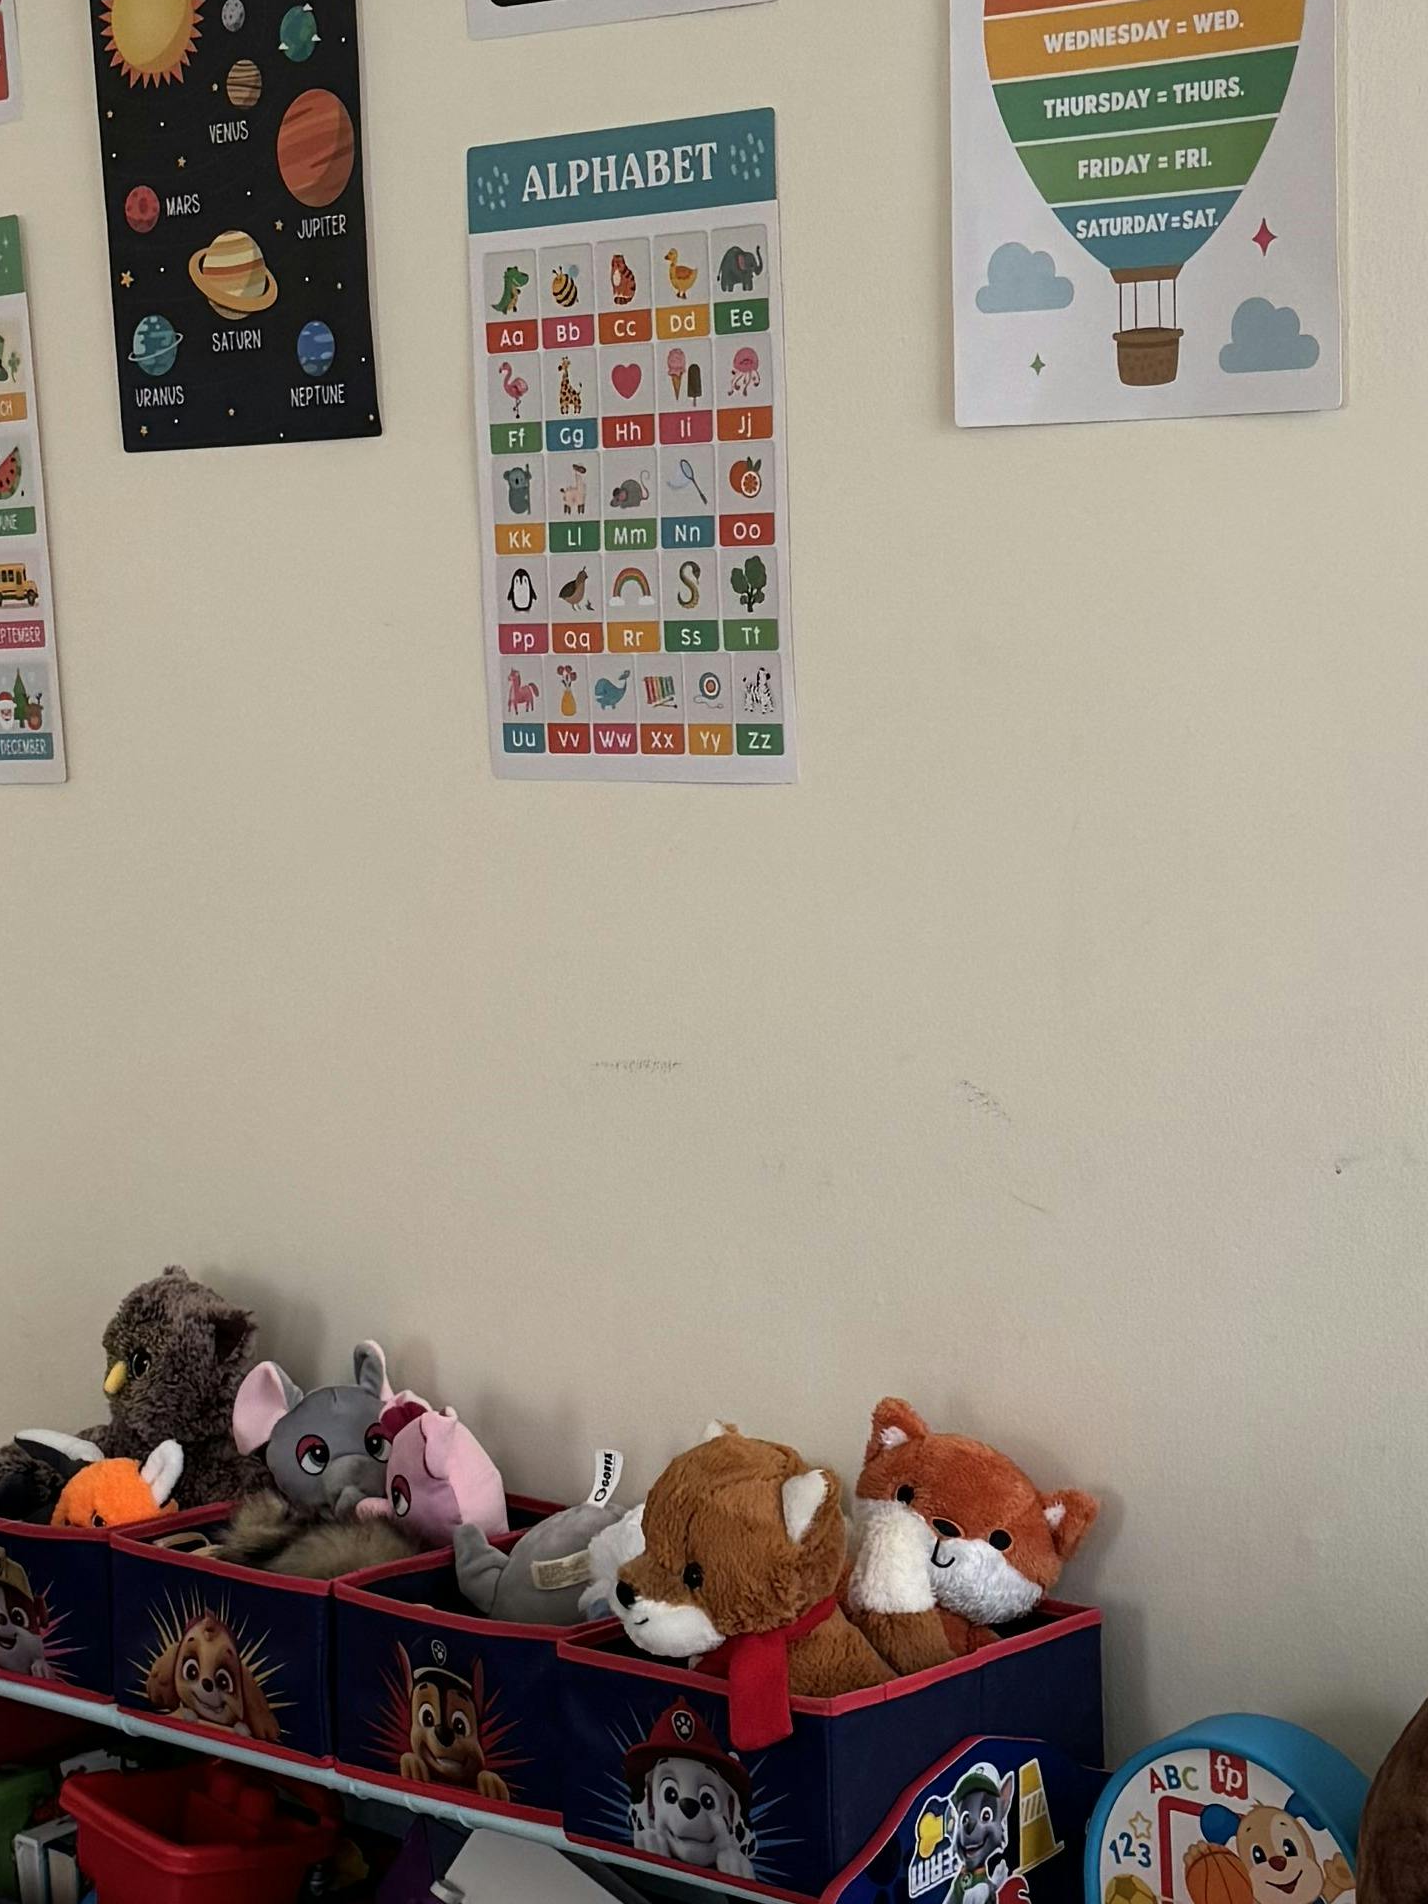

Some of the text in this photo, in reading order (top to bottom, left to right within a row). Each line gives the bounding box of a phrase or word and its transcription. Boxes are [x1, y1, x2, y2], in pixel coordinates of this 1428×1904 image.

[1043, 18, 1171, 54] WEDNESDAY
[1192, 9, 1245, 34] WED.
[1043, 87, 1151, 119] THURSDAY
[1172, 76, 1245, 104] THURS.
[208, 119, 249, 144] VENUS
[521, 141, 718, 203] ALPHABET
[1077, 153, 1151, 180] FRIDAY
[1175, 147, 1213, 170] FRI.
[165, 193, 201, 217] MARS
[296, 213, 347, 240] JUPITER
[1076, 212, 1169, 240] SATURDAY
[1182, 207, 1219, 230] SAT.
[211, 328, 262, 352] SATURN
[499, 308, 754, 347] Aa Bb Cc Dd Ee
[135, 385, 185, 408] URANUS
[290, 383, 345, 408] NEPTUNE
[508, 412, 752, 449] Ff Gg Hh Ii Jj
[508, 521, 761, 549] Kk Ll Mm Nn Oo
[512, 626, 761, 652] Pp Qq Rr Ss Tt
[0, 738, 48, 756] DECEMBER
[512, 730, 772, 753] Uu Vv Ww Xx Yy Zz
[1149, 1764, 1199, 1794] ABC
[1214, 1754, 1243, 1792] fp
